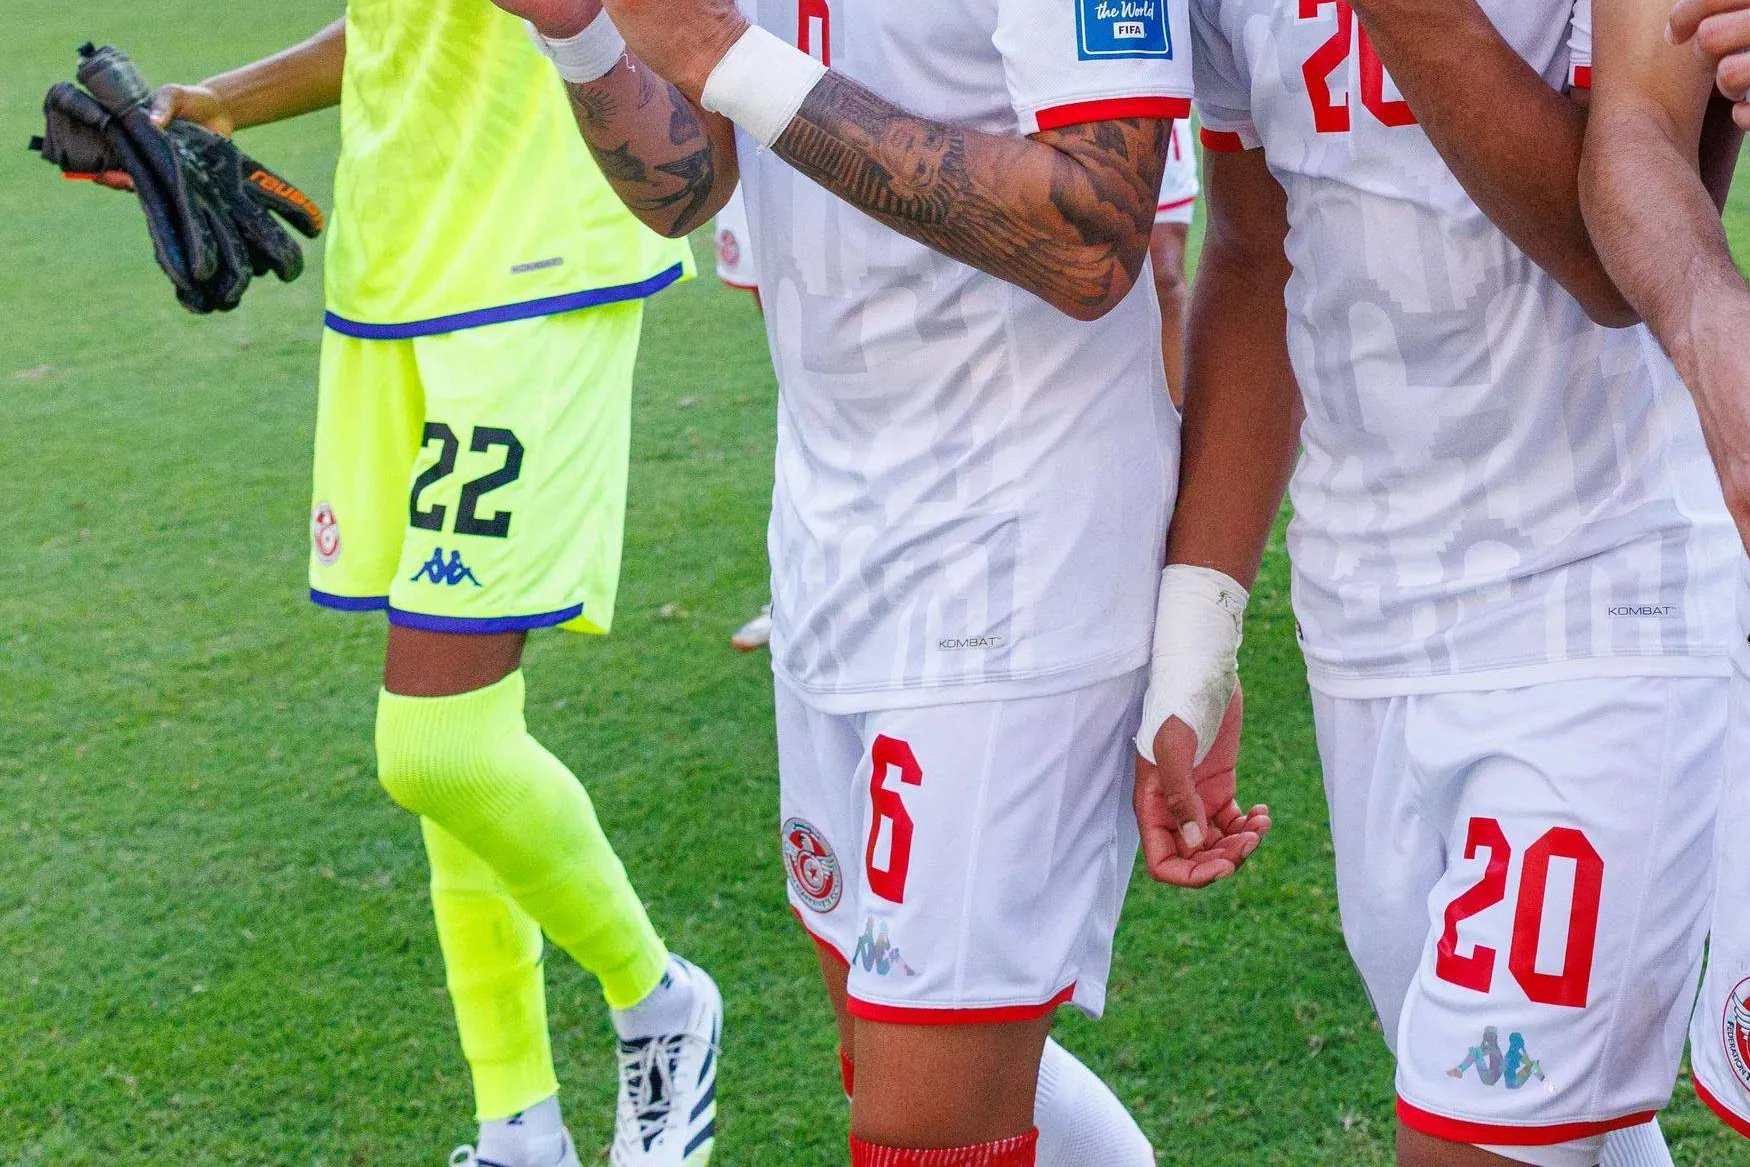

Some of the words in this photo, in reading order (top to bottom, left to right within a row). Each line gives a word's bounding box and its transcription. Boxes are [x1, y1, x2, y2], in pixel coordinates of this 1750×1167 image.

[1094, 2, 1119, 20] the
[1120, 1, 1155, 21] World
[1118, 25, 1142, 35] FIFA
[410, 421, 525, 538] 22
[1608, 606, 1672, 616] KOMBAT
[939, 637, 995, 649] KOMBAT
[866, 733, 923, 904] 6
[1435, 817, 1604, 1008] 20
